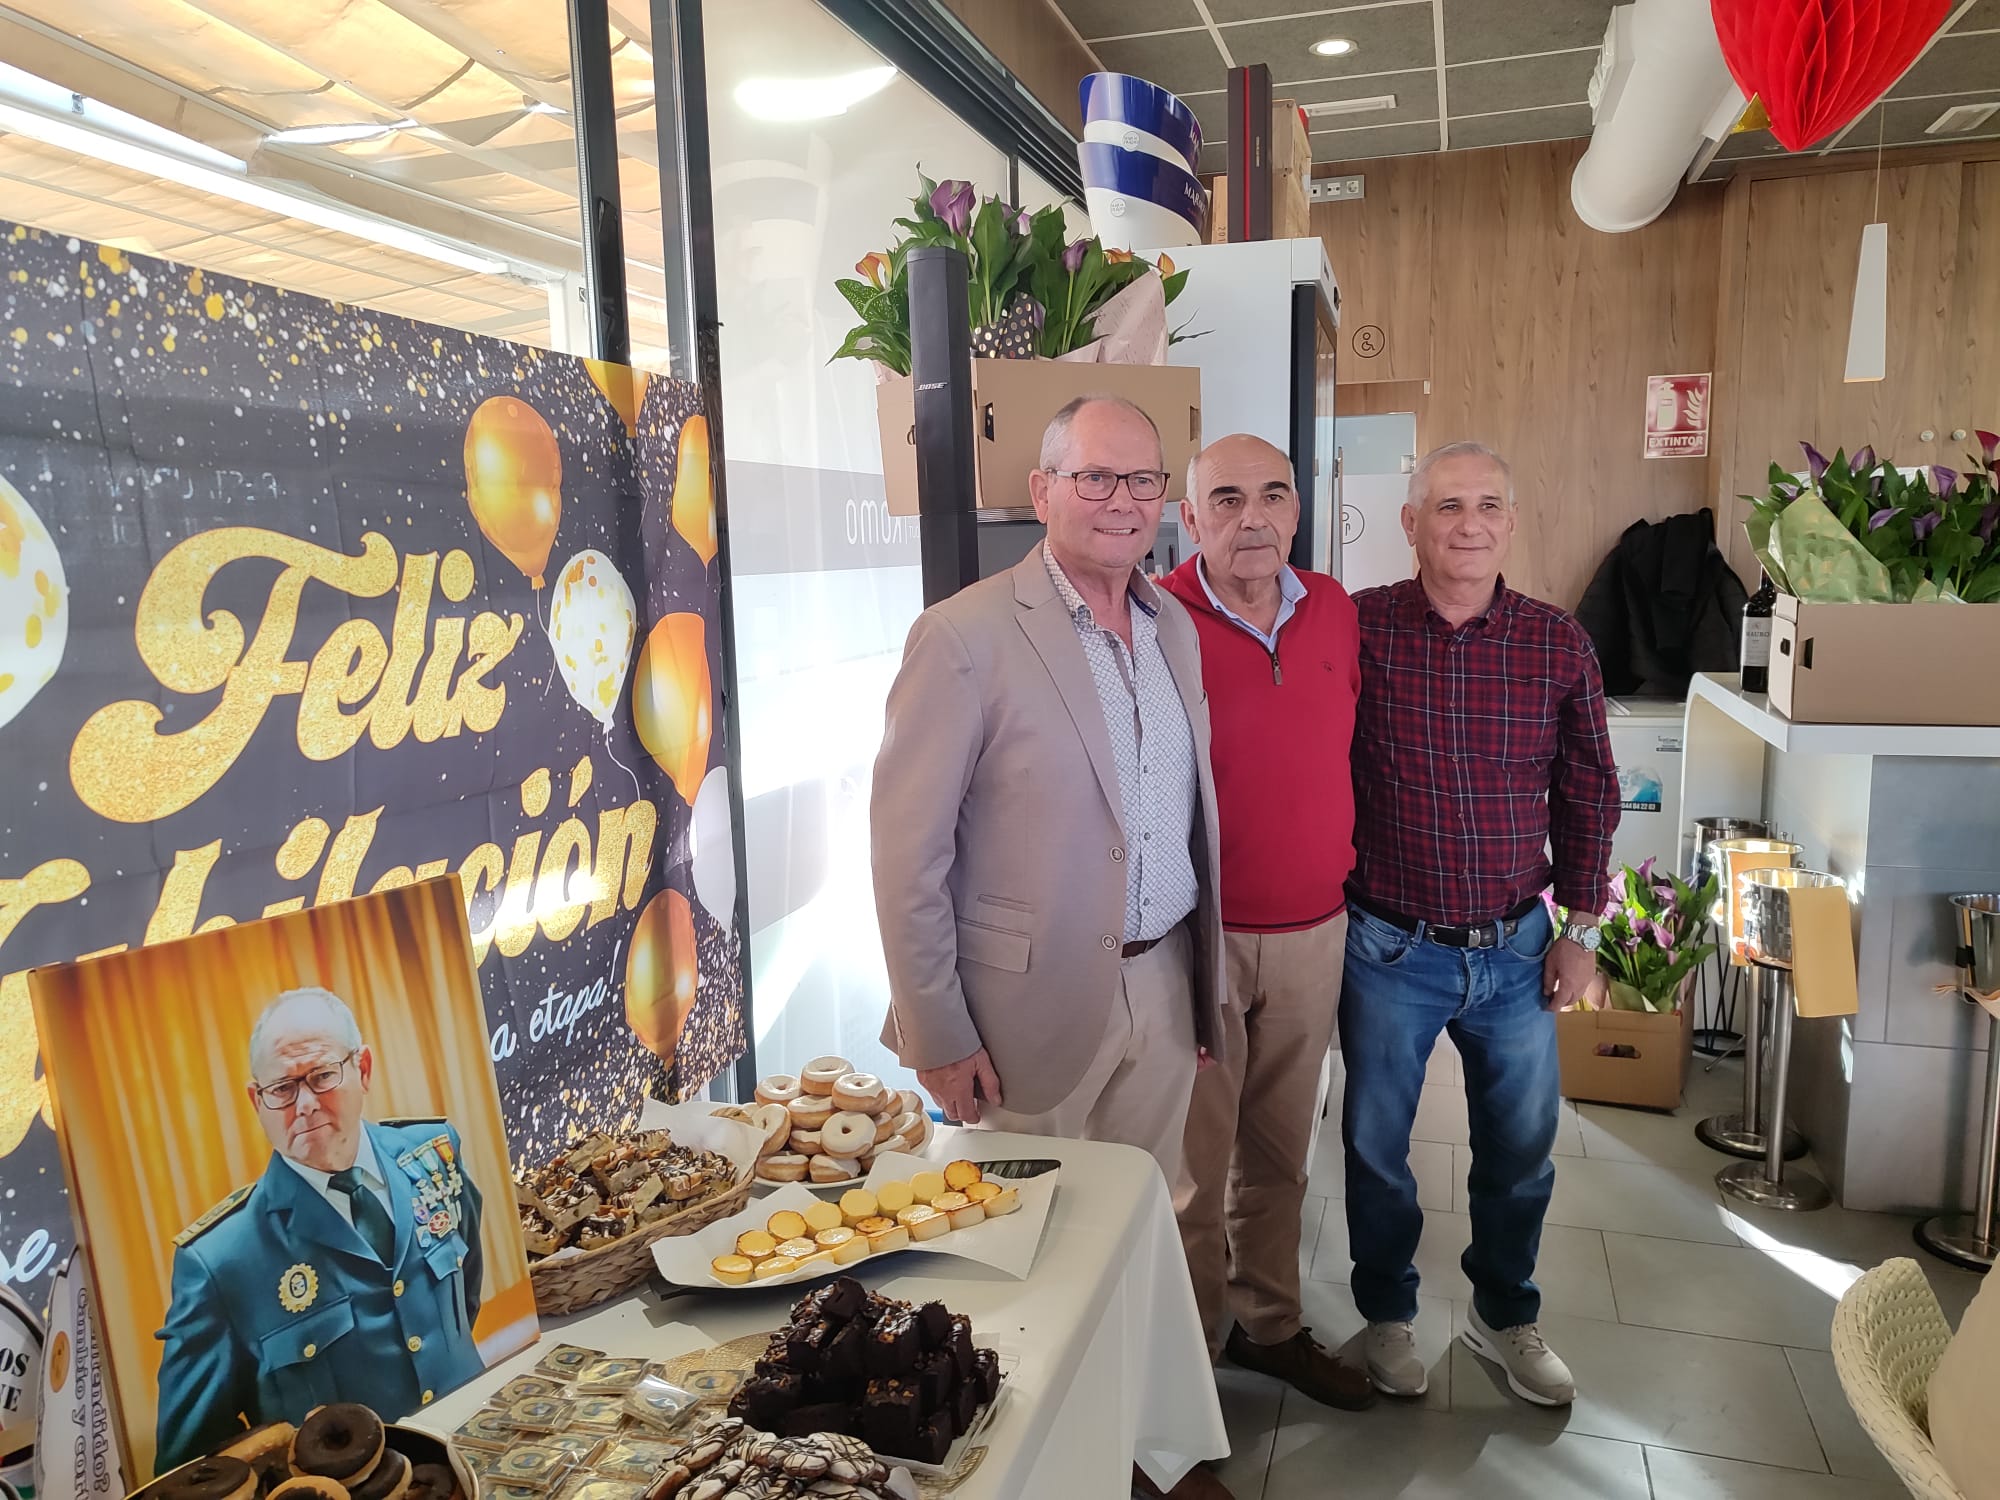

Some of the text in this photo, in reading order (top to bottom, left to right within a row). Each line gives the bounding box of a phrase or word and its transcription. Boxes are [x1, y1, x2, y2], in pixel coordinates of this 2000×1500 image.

[915, 382, 948, 391] BOSE
[1648, 436, 1704, 448] EXTINTOR
[69, 526, 524, 823] Feliz
[529, 939, 622, 1047] etapa!
[74, 1288, 89, 1400] Cambio
[71, 1404, 86, 1427] y
